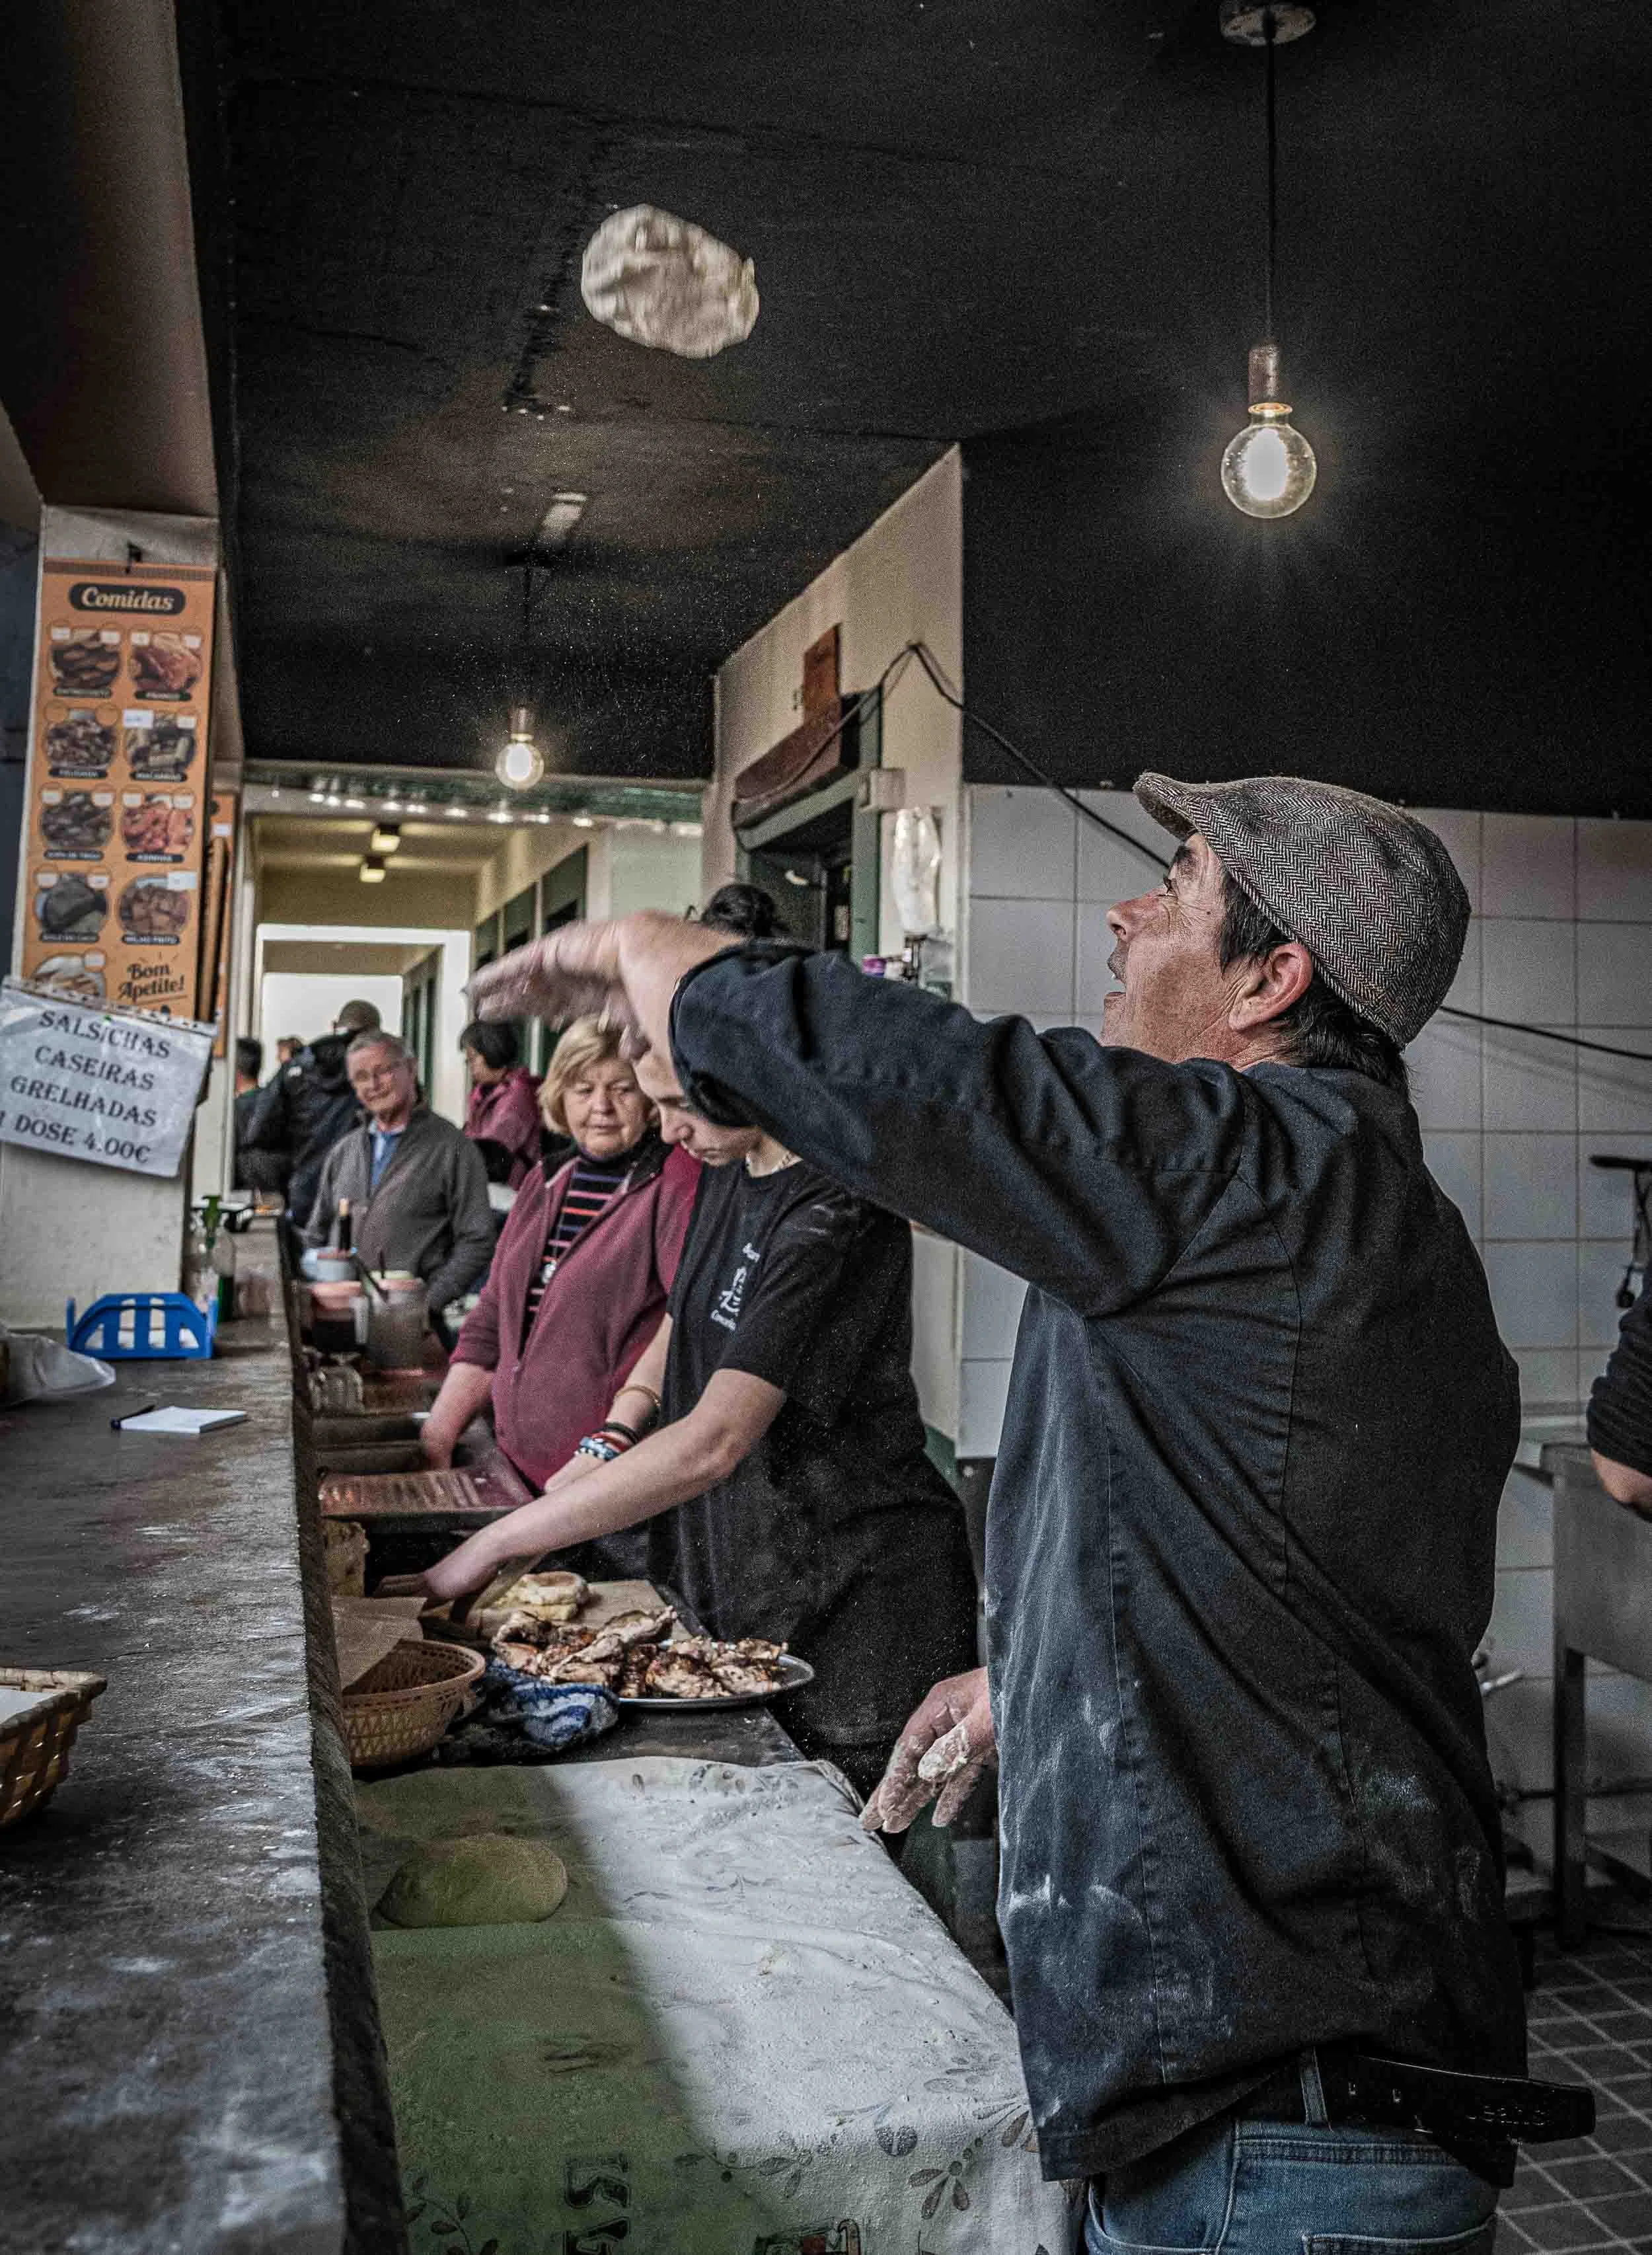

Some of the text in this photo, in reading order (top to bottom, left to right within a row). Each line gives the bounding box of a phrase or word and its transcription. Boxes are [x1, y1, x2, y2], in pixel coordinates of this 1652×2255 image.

[81, 587, 174, 611] Comidas
[127, 963, 170, 980] Bom
[118, 974, 185, 1003] Apetite!
[38, 1010, 170, 1058] SALSICHAS
[35, 1046, 155, 1090] CASEIRAS
[10, 1075, 157, 1127] GRELHADAS
[13, 1114, 77, 1146] DOSE
